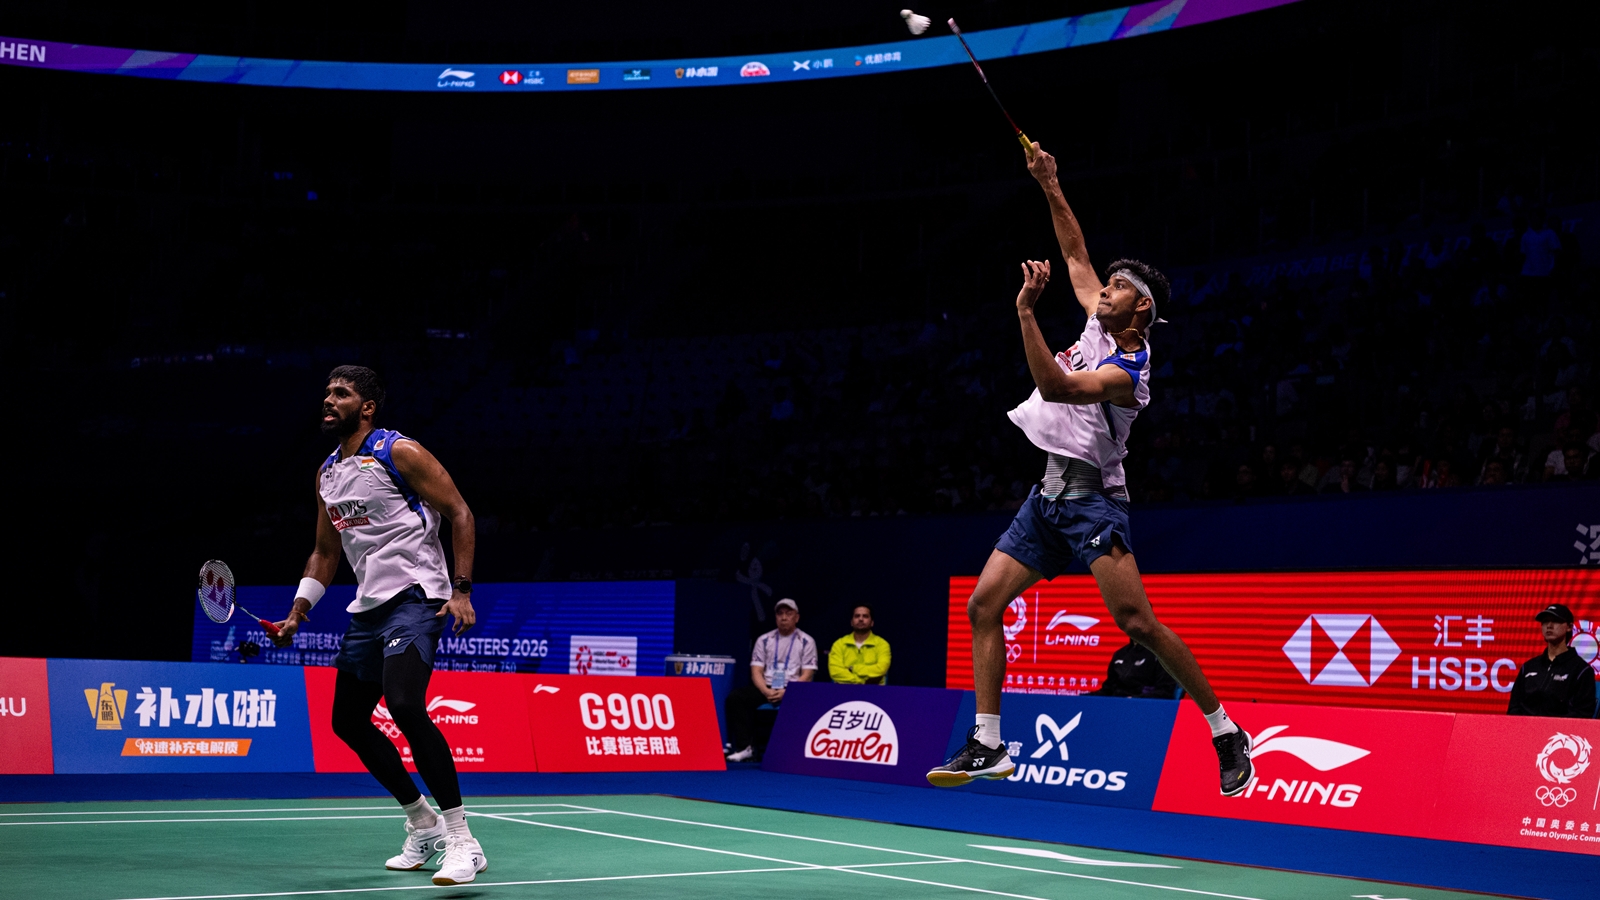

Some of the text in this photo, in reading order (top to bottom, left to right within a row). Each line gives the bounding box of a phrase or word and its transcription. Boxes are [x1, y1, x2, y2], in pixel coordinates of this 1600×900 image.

[0, 41, 46, 63] HEN
[338, 499, 368, 519] DBS
[1044, 634, 1100, 647] LI-NING
[1433, 614, 1495, 648] 汇丰
[447, 637, 510, 656] MASTERS
[512, 639, 549, 657] 2026
[432, 659, 449, 671] orld
[1411, 656, 1517, 693] HSBC
[135, 686, 277, 728] 补水啦
[579, 692, 675, 731] G900
[827, 709, 884, 732] 百岁山
[137, 740, 238, 755] 快速补充电解质
[585, 736, 681, 756] 比赛指定用球
[1001, 740, 1023, 756] 富
[1003, 763, 1129, 792] UNDFOS
[1231, 776, 1363, 808] I-NING
[1520, 828, 1548, 838] Chinese
[1548, 831, 1579, 842] Olympic
